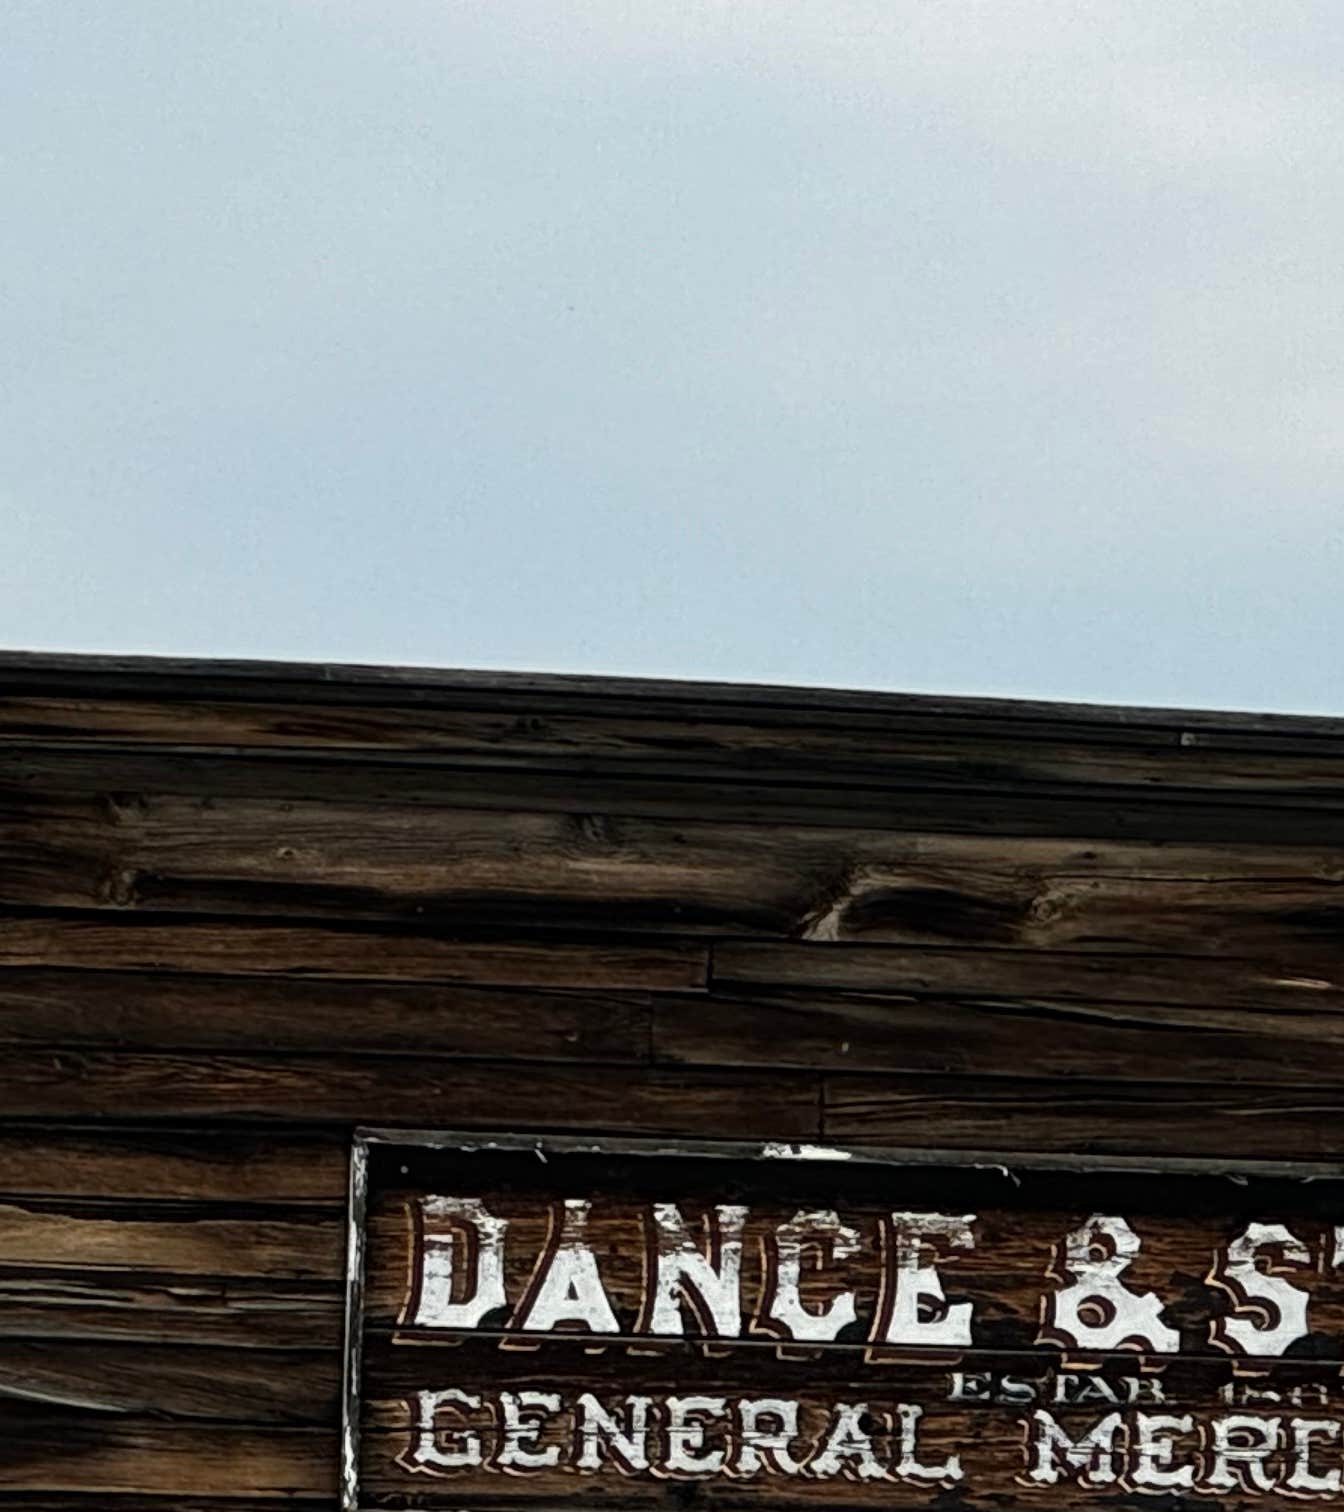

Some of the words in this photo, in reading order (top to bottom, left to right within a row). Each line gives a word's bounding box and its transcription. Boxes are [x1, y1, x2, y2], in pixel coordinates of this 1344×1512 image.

[404, 1193, 978, 1350] DANCE
[1048, 1211, 1180, 1357] &
[408, 1387, 965, 1486] GENERAL
